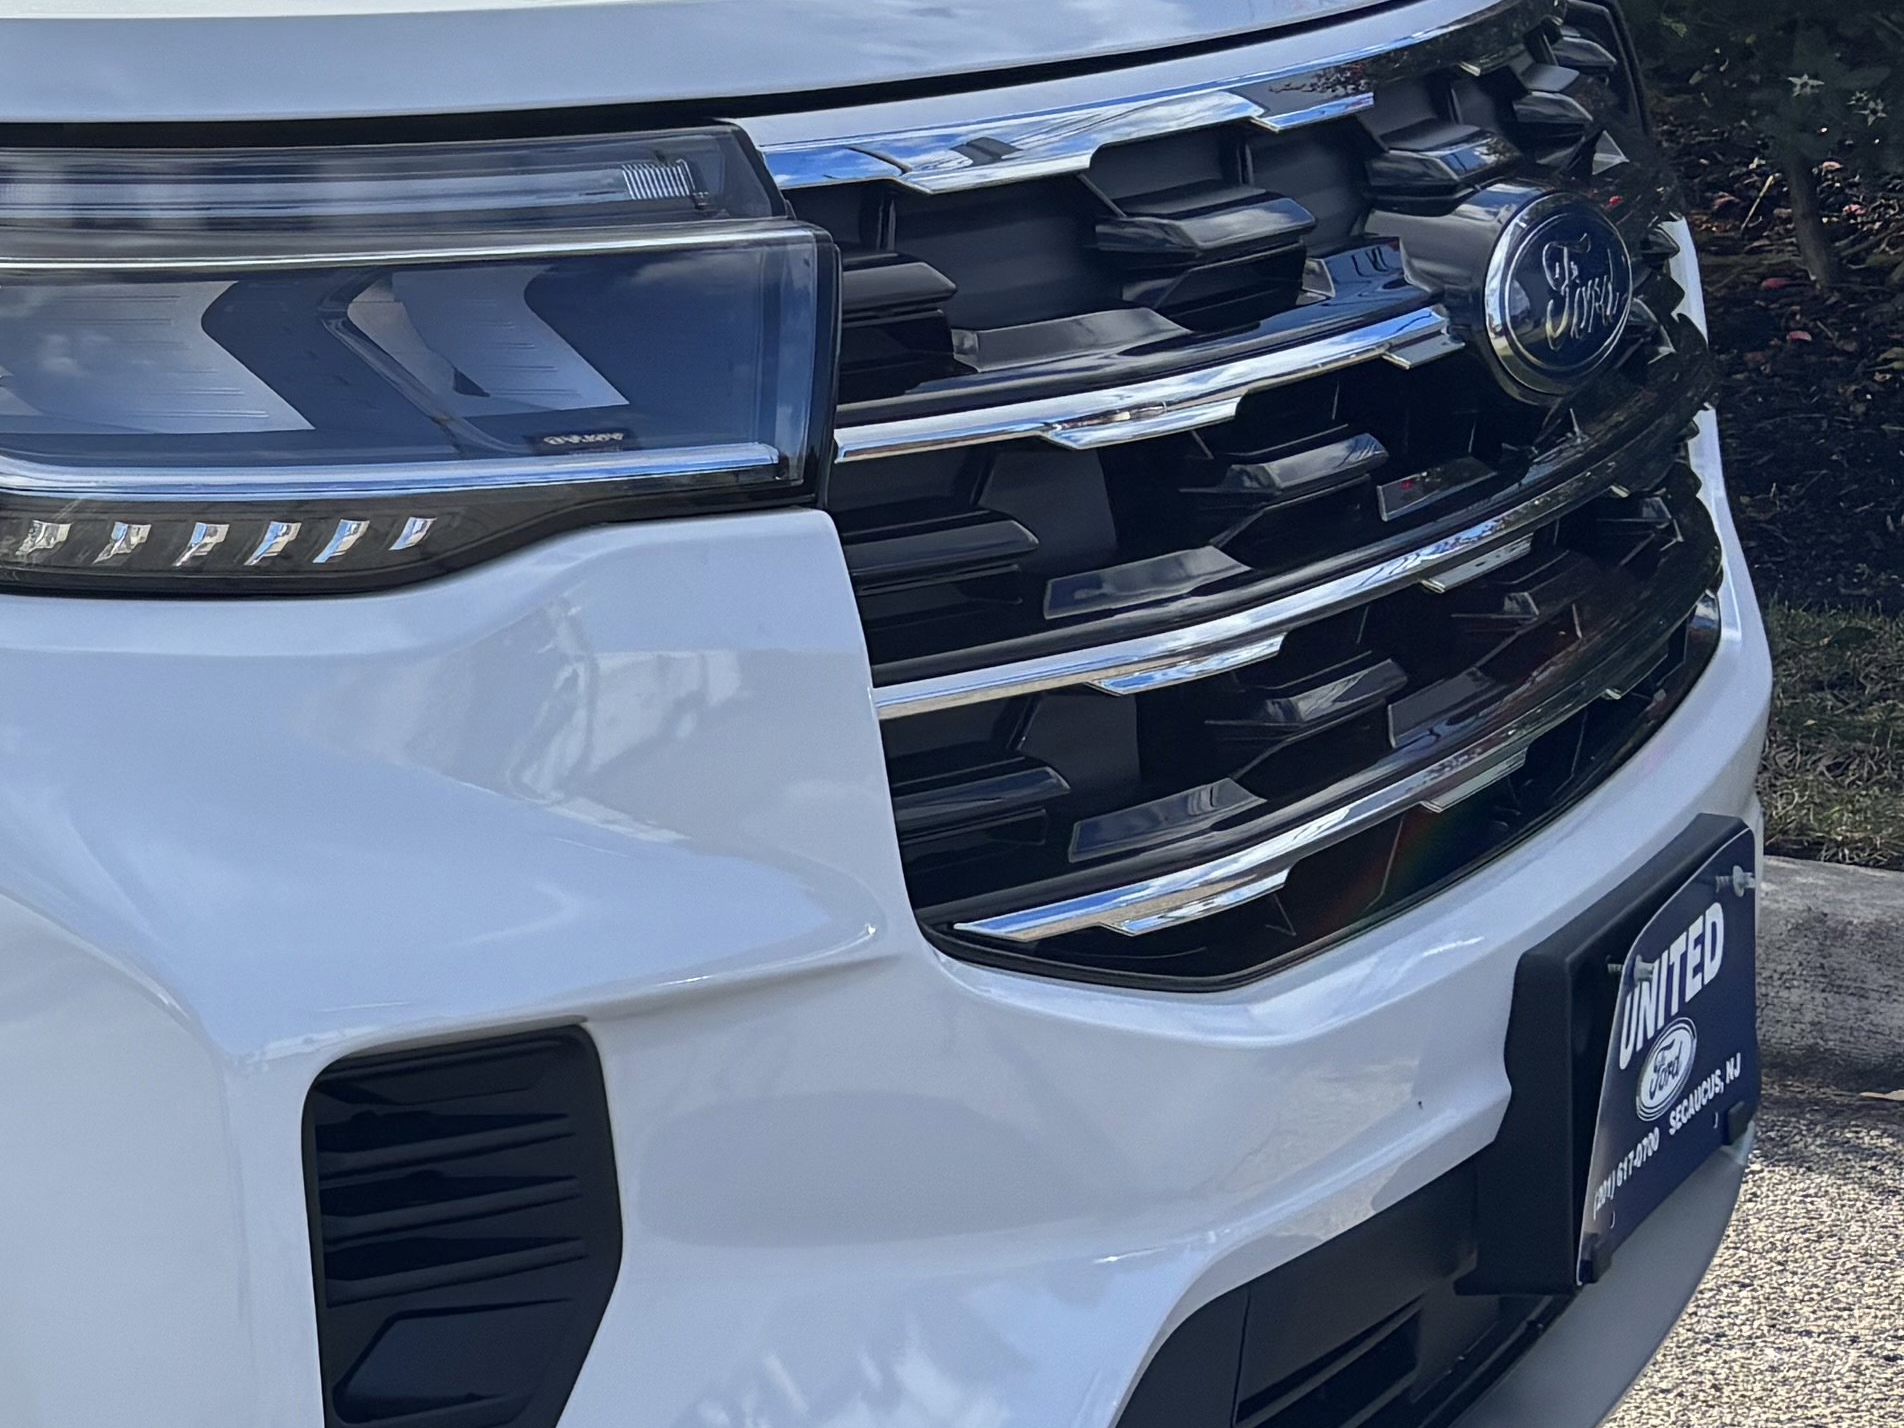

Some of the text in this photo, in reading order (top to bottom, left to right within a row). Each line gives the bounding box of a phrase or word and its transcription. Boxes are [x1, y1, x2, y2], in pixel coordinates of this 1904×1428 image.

[1619, 902, 1724, 1070] UNITED
[1669, 1069, 1724, 1135] SECAUCUS,
[1726, 1052, 1741, 1084] NJ
